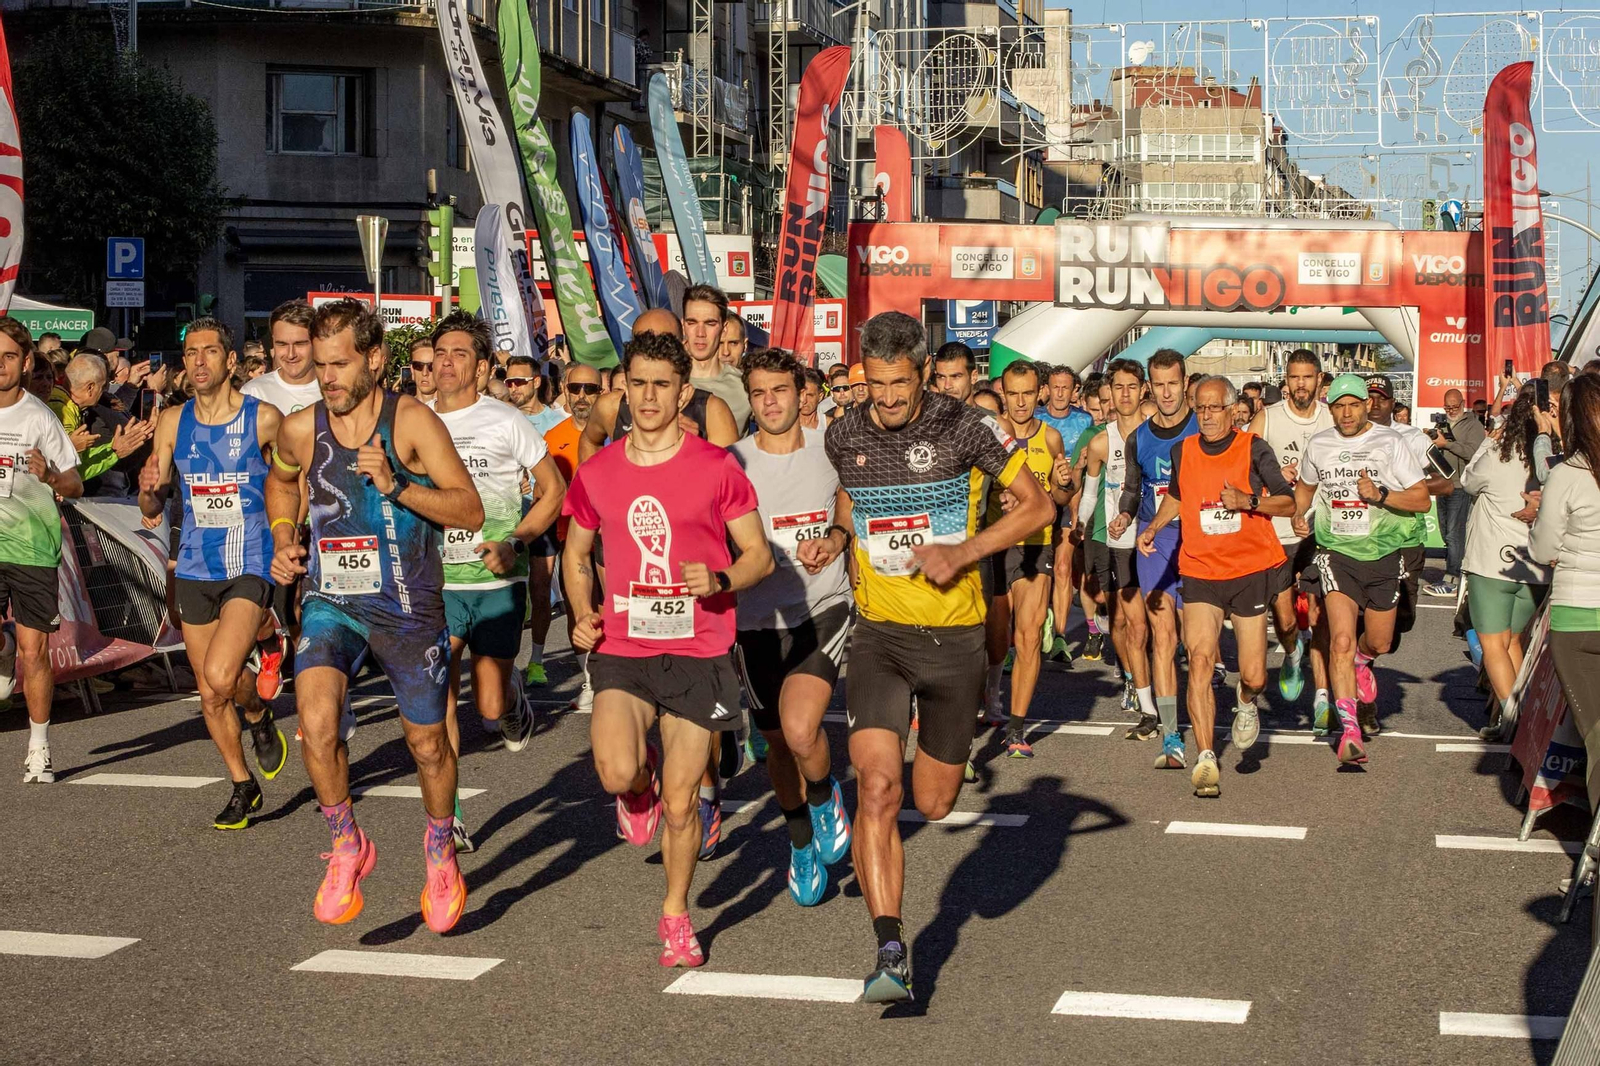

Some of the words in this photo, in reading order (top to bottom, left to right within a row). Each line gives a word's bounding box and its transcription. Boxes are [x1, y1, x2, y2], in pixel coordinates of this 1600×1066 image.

[1059, 225, 1165, 263] RUN
[115, 242, 137, 273] P
[856, 245, 909, 265] VIGO
[956, 253, 1009, 262] CONCELLO
[962, 263, 975, 271] DE
[978, 263, 1002, 272] VIGO
[1303, 259, 1356, 268] CONCELLO
[1412, 254, 1466, 275] VIGO
[860, 264, 932, 276] DEPORTE
[1309, 269, 1322, 278] DE
[1326, 269, 1350, 278] VIGO
[1493, 227, 1515, 327] RUN
[483, 247, 515, 352] ónsalud
[747, 313, 765, 321] RUN
[971, 311, 988, 319] 24H
[30, 320, 43, 330] EL
[44, 318, 89, 330] CÁNCER
[1430, 332, 1482, 344] amura
[1365, 377, 1387, 386] SPAÑA
[1443, 378, 1484, 387] HYUNDAI
[183, 472, 250, 484] SOLISS
[1320, 469, 1332, 480] En
[206, 497, 234, 510] 206
[1341, 510, 1364, 520] 399
[447, 532, 475, 544] 649
[889, 532, 925, 550] 640
[338, 553, 371, 569] 456
[650, 601, 686, 615] 452
